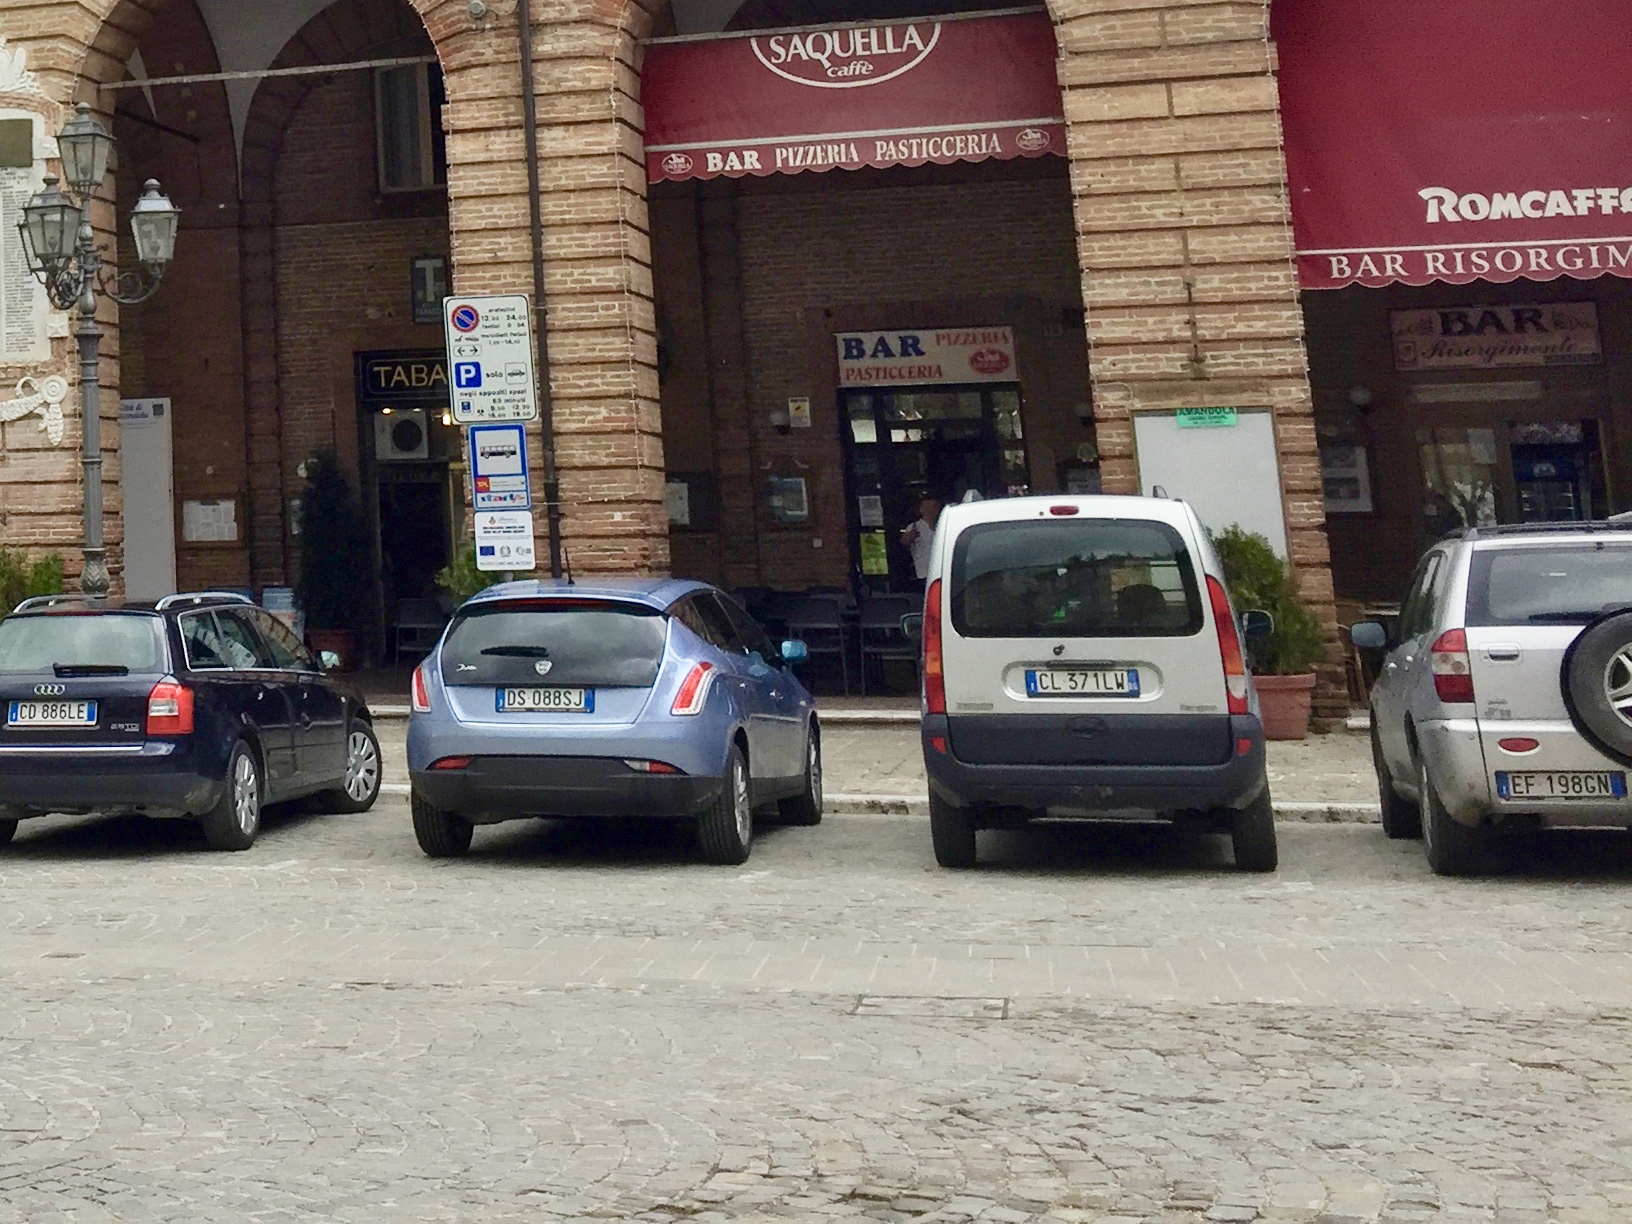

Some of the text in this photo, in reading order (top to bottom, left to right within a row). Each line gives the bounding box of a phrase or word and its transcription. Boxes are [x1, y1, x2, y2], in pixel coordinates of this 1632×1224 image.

[769, 24, 926, 69] SAQUELLA
[826, 60, 874, 78] caffè
[705, 133, 1002, 173] BAR PIZZERIA PASTICCERIA
[1329, 254, 1410, 279] BAR
[1438, 307, 1550, 336] BAR
[842, 330, 1010, 360] BAR PIZZERIA
[844, 364, 944, 381] PASTICCERIA
[1038, 672, 1126, 691] CL 371LW
[507, 689, 583, 706] DS 088SJ
[19, 703, 86, 719] CD 886LE
[1511, 774, 1610, 794] EF 198GN
